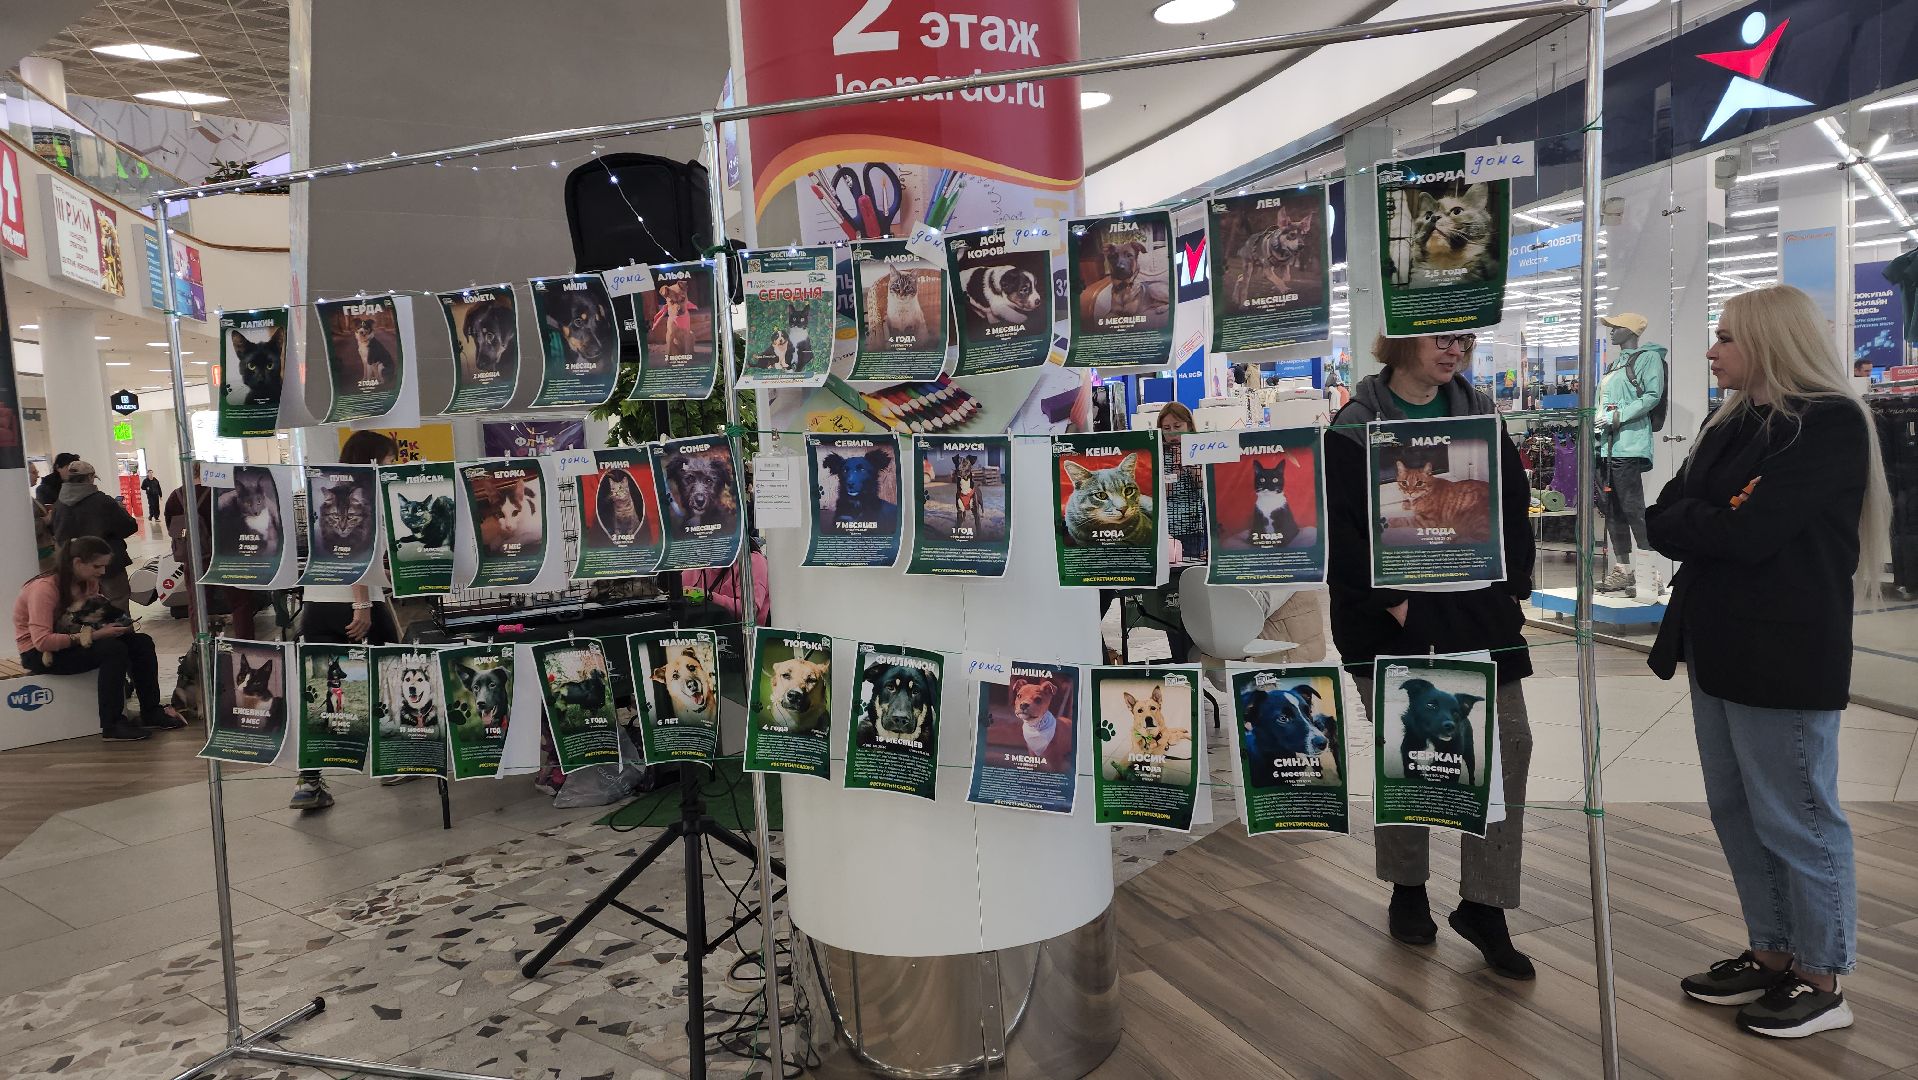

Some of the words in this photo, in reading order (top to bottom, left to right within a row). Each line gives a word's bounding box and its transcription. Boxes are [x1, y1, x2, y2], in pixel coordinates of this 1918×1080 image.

[832, 0, 899, 56] 2
[919, 11, 1040, 58] этаж
[1471, 155, 1524, 175] дома
[1416, 169, 1465, 184] ХОРДА
[1256, 198, 1281, 210] ЛЕЯ
[1109, 221, 1139, 233] ЛЁХА
[884, 254, 920, 263] АМОРЕ
[968, 248, 1007, 259] КОРОВ
[611, 274, 646, 290] дома
[658, 271, 692, 282] АЛЬФА
[759, 286, 823, 301] СЕГОДНЯ
[1251, 294, 1299, 306] МЕСЯЦЕВ
[343, 305, 383, 316] ГЕРДА
[240, 318, 274, 328] ЛАПКИН
[1105, 315, 1147, 325] МЕСЯЦЕВ
[992, 324, 1026, 335] МЕСЯЦА
[895, 335, 917, 343] ГОДА
[943, 442, 984, 451] МАРУСЯ
[1412, 435, 1451, 447] МАРС
[1085, 446, 1122, 457] КЕША
[1239, 444, 1284, 455] МИЛКА
[957, 527, 974, 536] ГОД
[1100, 530, 1124, 538] ГОДА
[1261, 532, 1283, 541] года
[1426, 527, 1456, 536] ГОДА
[783, 638, 823, 651] ТЮРЬКА
[875, 655, 936, 671] ФИЛИМОН
[969, 660, 1005, 674] дома
[1004, 753, 1010, 761] 3
[1012, 754, 1047, 764] МЕСЯЦА
[1274, 757, 1320, 768] СИНАН
[1408, 750, 1463, 764] СЕРКАН
[1141, 764, 1162, 773] года
[1409, 763, 1414, 771] 6
[1416, 765, 1461, 776] месяцев
[1280, 770, 1322, 779] месяцев
